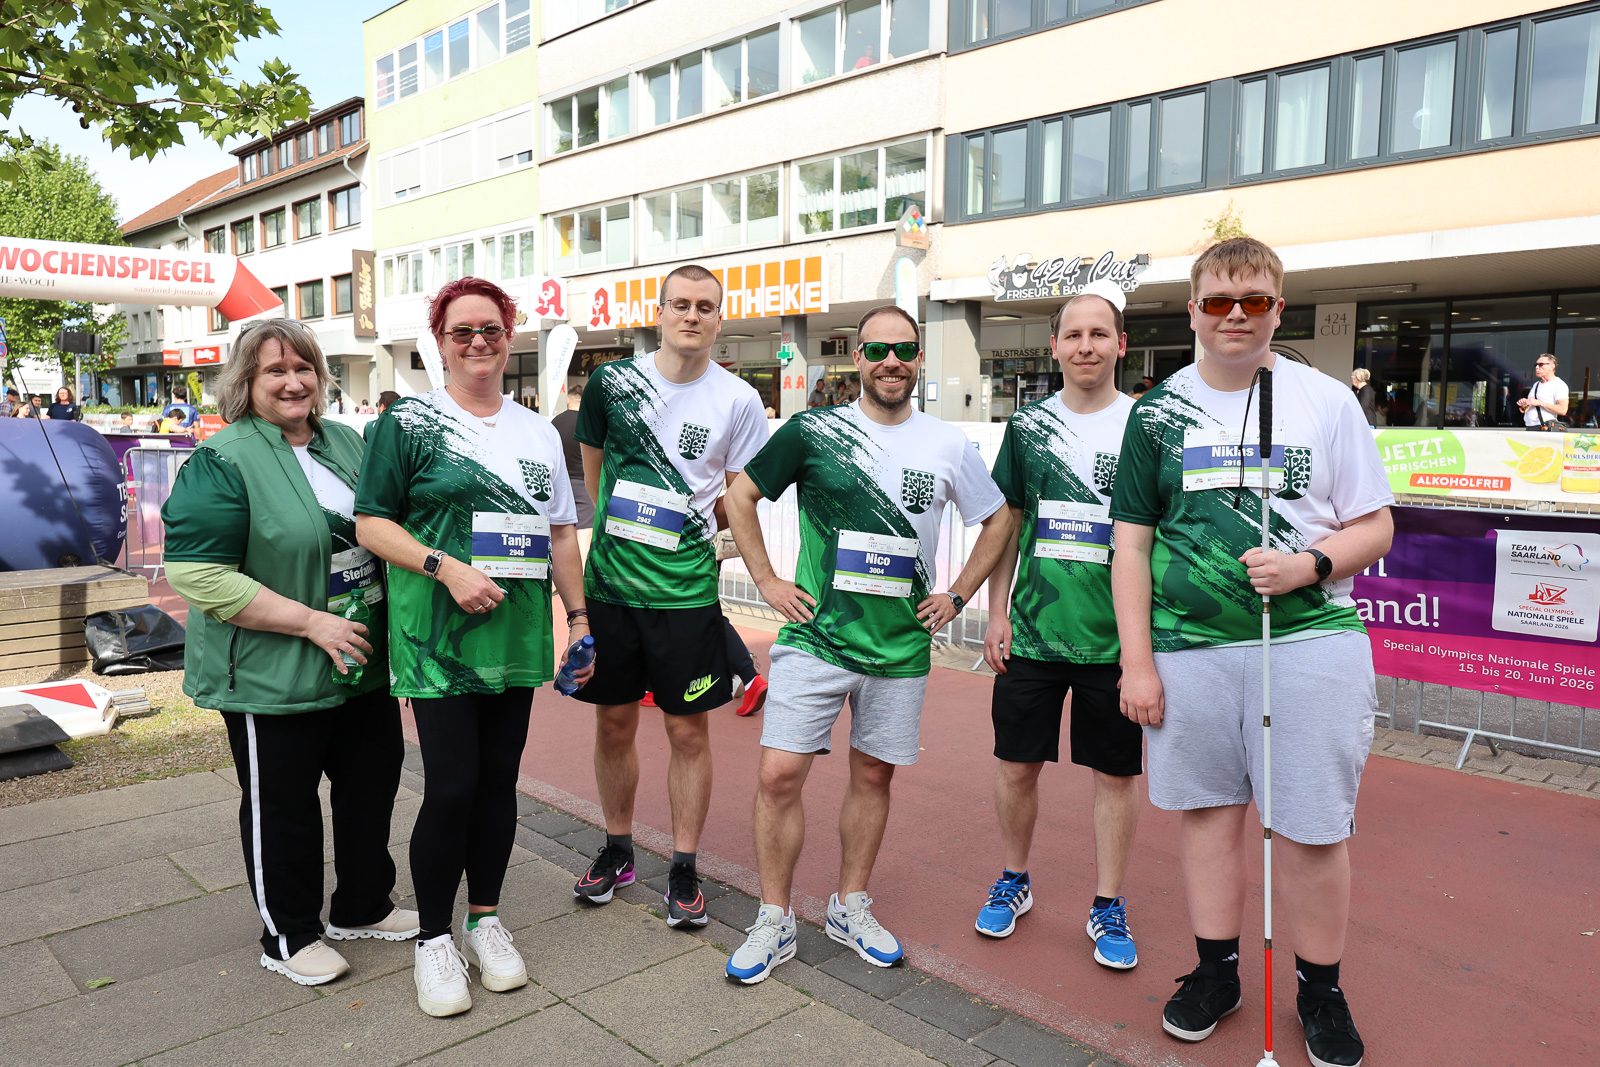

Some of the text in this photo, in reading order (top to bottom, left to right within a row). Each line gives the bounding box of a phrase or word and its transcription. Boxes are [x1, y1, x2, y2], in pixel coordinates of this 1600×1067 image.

[0, 247, 215, 284] WOCHENSPIEGEL
[1031, 255, 1081, 288] 424
[359, 257, 373, 311] Tchibo
[133, 286, 216, 297] saarland-journal.de
[1006, 286, 1050, 300] FRISEUR
[1051, 284, 1061, 296] &
[615, 281, 821, 327] RATTHEKE
[1324, 313, 1347, 324] 424
[1320, 324, 1351, 336] CUT
[992, 348, 1040, 358] TALSTRASSE
[1211, 446, 1255, 458] Niklas
[1382, 437, 1444, 462] JETZT
[1383, 456, 1457, 475] RFRISCHEN
[1416, 477, 1504, 489] ALKOHOLFREI
[637, 502, 657, 517] Tim
[636, 516, 652, 525] 2942
[1048, 519, 1093, 533] Dominik
[501, 534, 532, 549] Tanja
[1511, 544, 1537, 552] TEAM
[508, 549, 525, 557] 2948
[865, 552, 891, 566] Nico
[1510, 551, 1562, 561] SAARLAND
[868, 566, 885, 575] 3004
[1356, 593, 1440, 628] and!
[1518, 604, 1574, 616] SPECIAL OLYMPICS
[1507, 610, 1585, 625] NATIONALE SPIELE
[1520, 619, 1553, 628] SAARLAND
[1383, 638, 1596, 679] Special Olympics Nationale Spiele
[688, 674, 712, 693] RUN
[1458, 663, 1595, 691] 15. bis 20. Juni 2026
